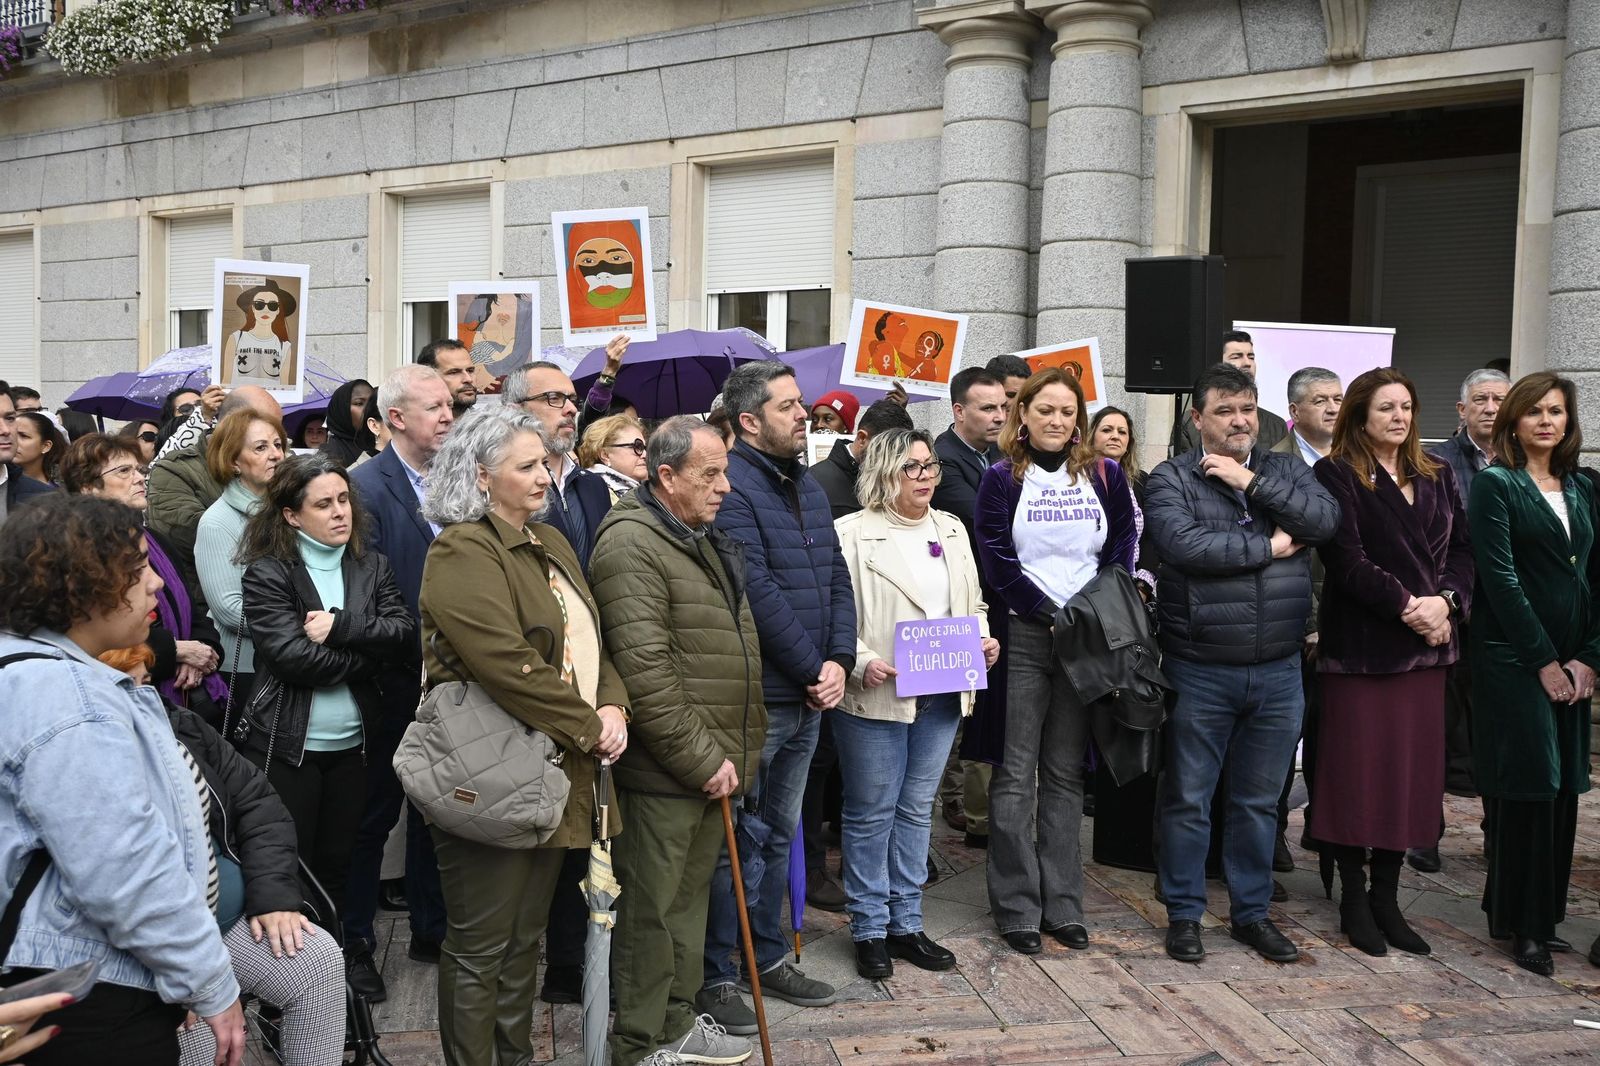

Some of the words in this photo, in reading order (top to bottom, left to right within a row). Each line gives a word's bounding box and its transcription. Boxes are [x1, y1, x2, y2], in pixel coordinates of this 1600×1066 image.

[1061, 487, 1082, 496] una
[1027, 508, 1102, 522] IGUALDAD
[929, 640, 942, 648] DE
